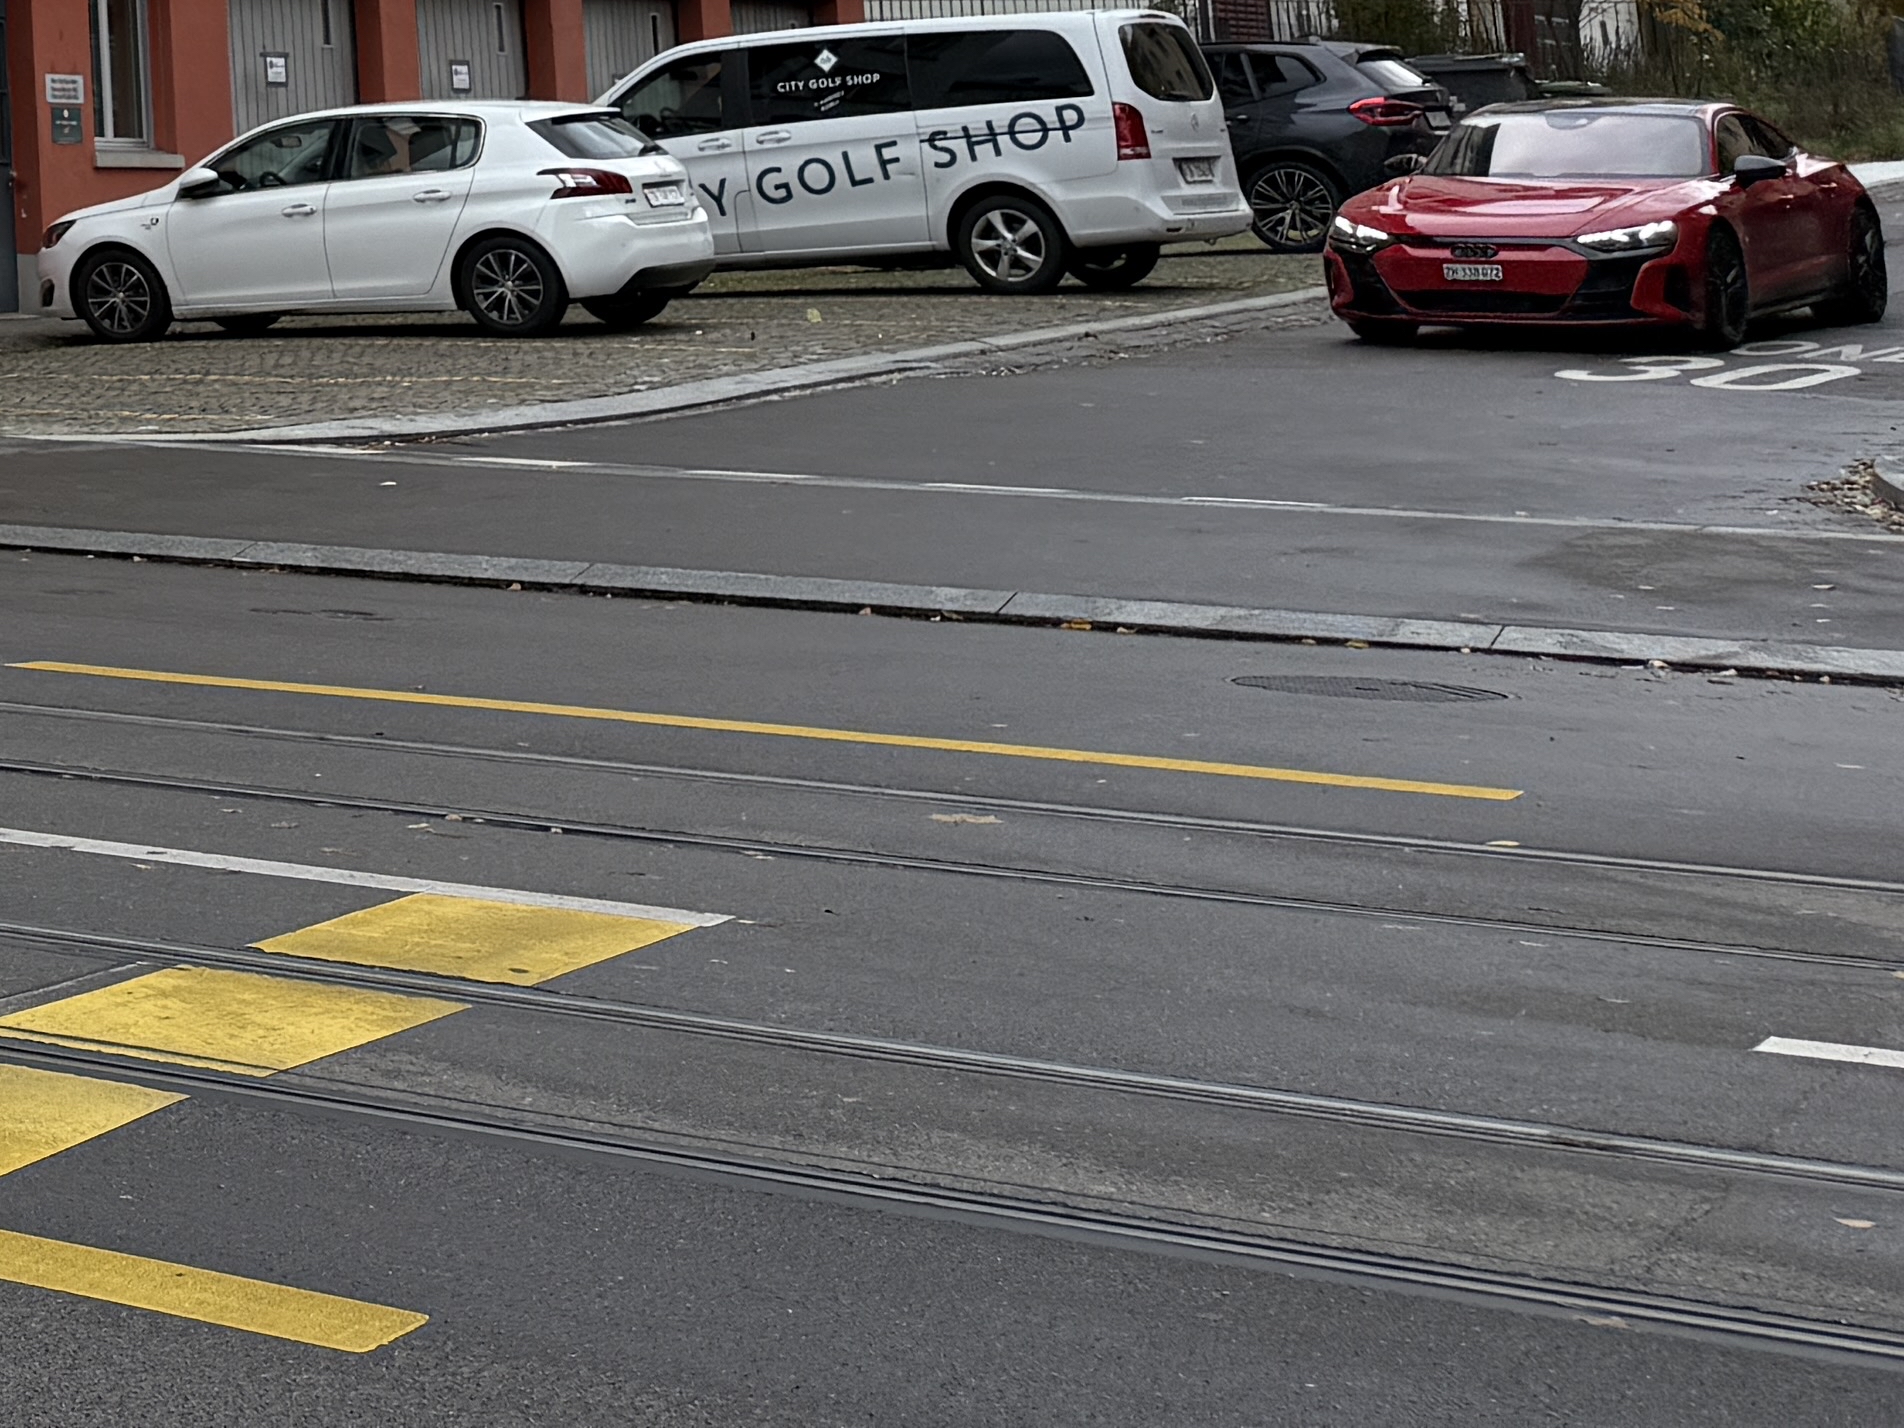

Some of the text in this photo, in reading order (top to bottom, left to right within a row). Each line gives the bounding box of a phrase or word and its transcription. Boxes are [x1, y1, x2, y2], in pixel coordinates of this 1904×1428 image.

[777, 72, 881, 93] CITY GOLF SHOP
[756, 140, 901, 205] GOLF
[927, 102, 1086, 170] SHOP
[1554, 355, 1861, 391] 30
